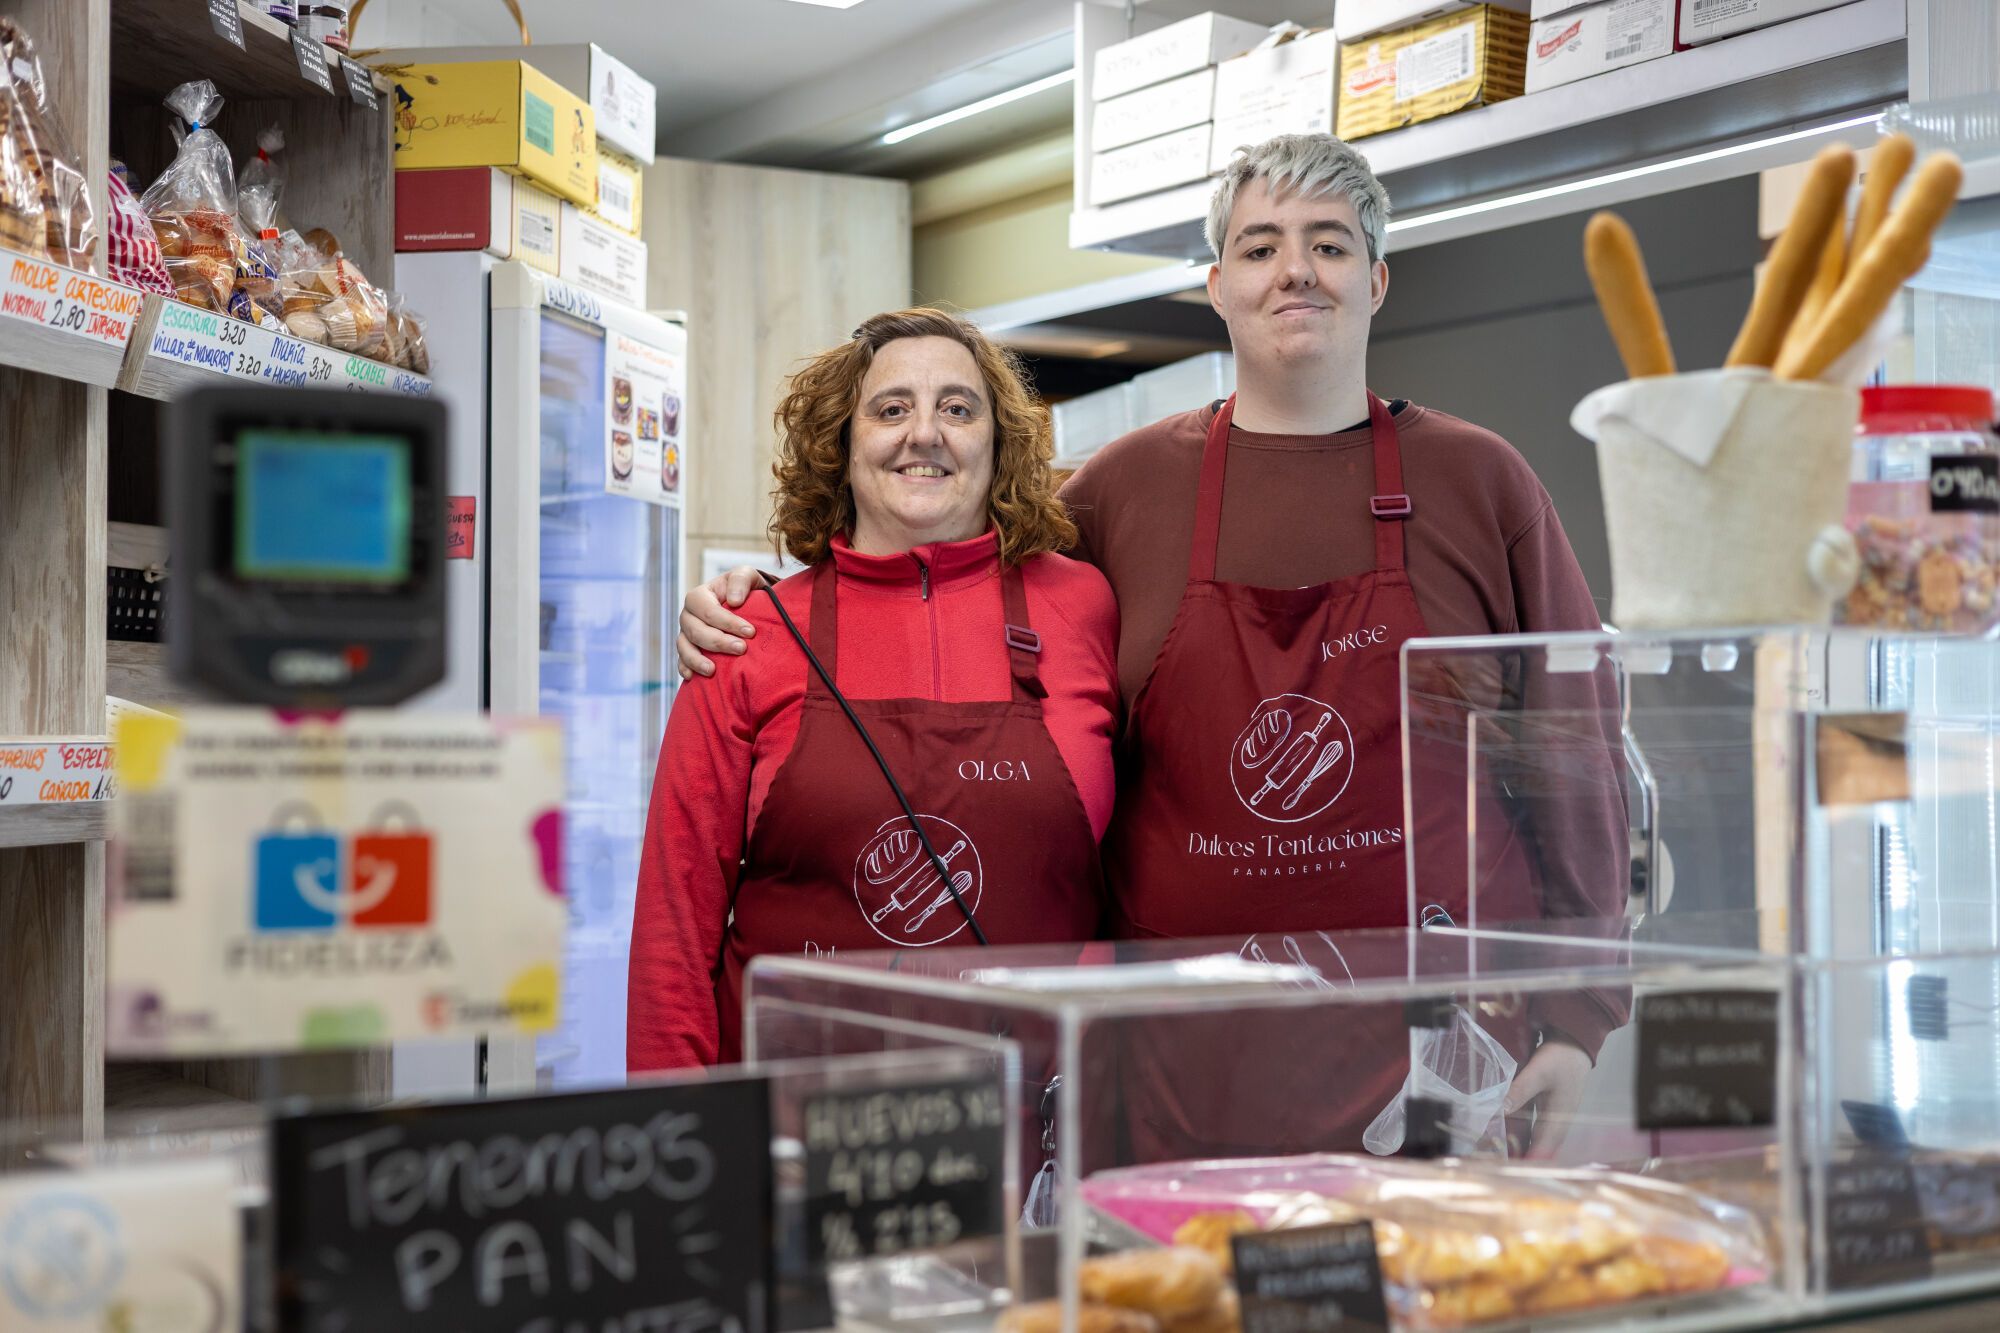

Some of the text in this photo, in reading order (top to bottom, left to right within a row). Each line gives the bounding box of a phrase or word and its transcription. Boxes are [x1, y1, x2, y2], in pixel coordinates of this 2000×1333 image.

[2, 291, 127, 341] NORMAL 2,80 INTEGRAL
[163, 304, 247, 346] ESCOSURA 3,20
[1321, 625, 1390, 662] JORGE
[958, 760, 1031, 781] OLGA
[1188, 826, 1402, 857] Dulces Tentaciones
[805, 1092, 962, 1151] HUEVOS
[308, 1110, 716, 1230] Tenemos
[394, 1208, 637, 1312] PAN
